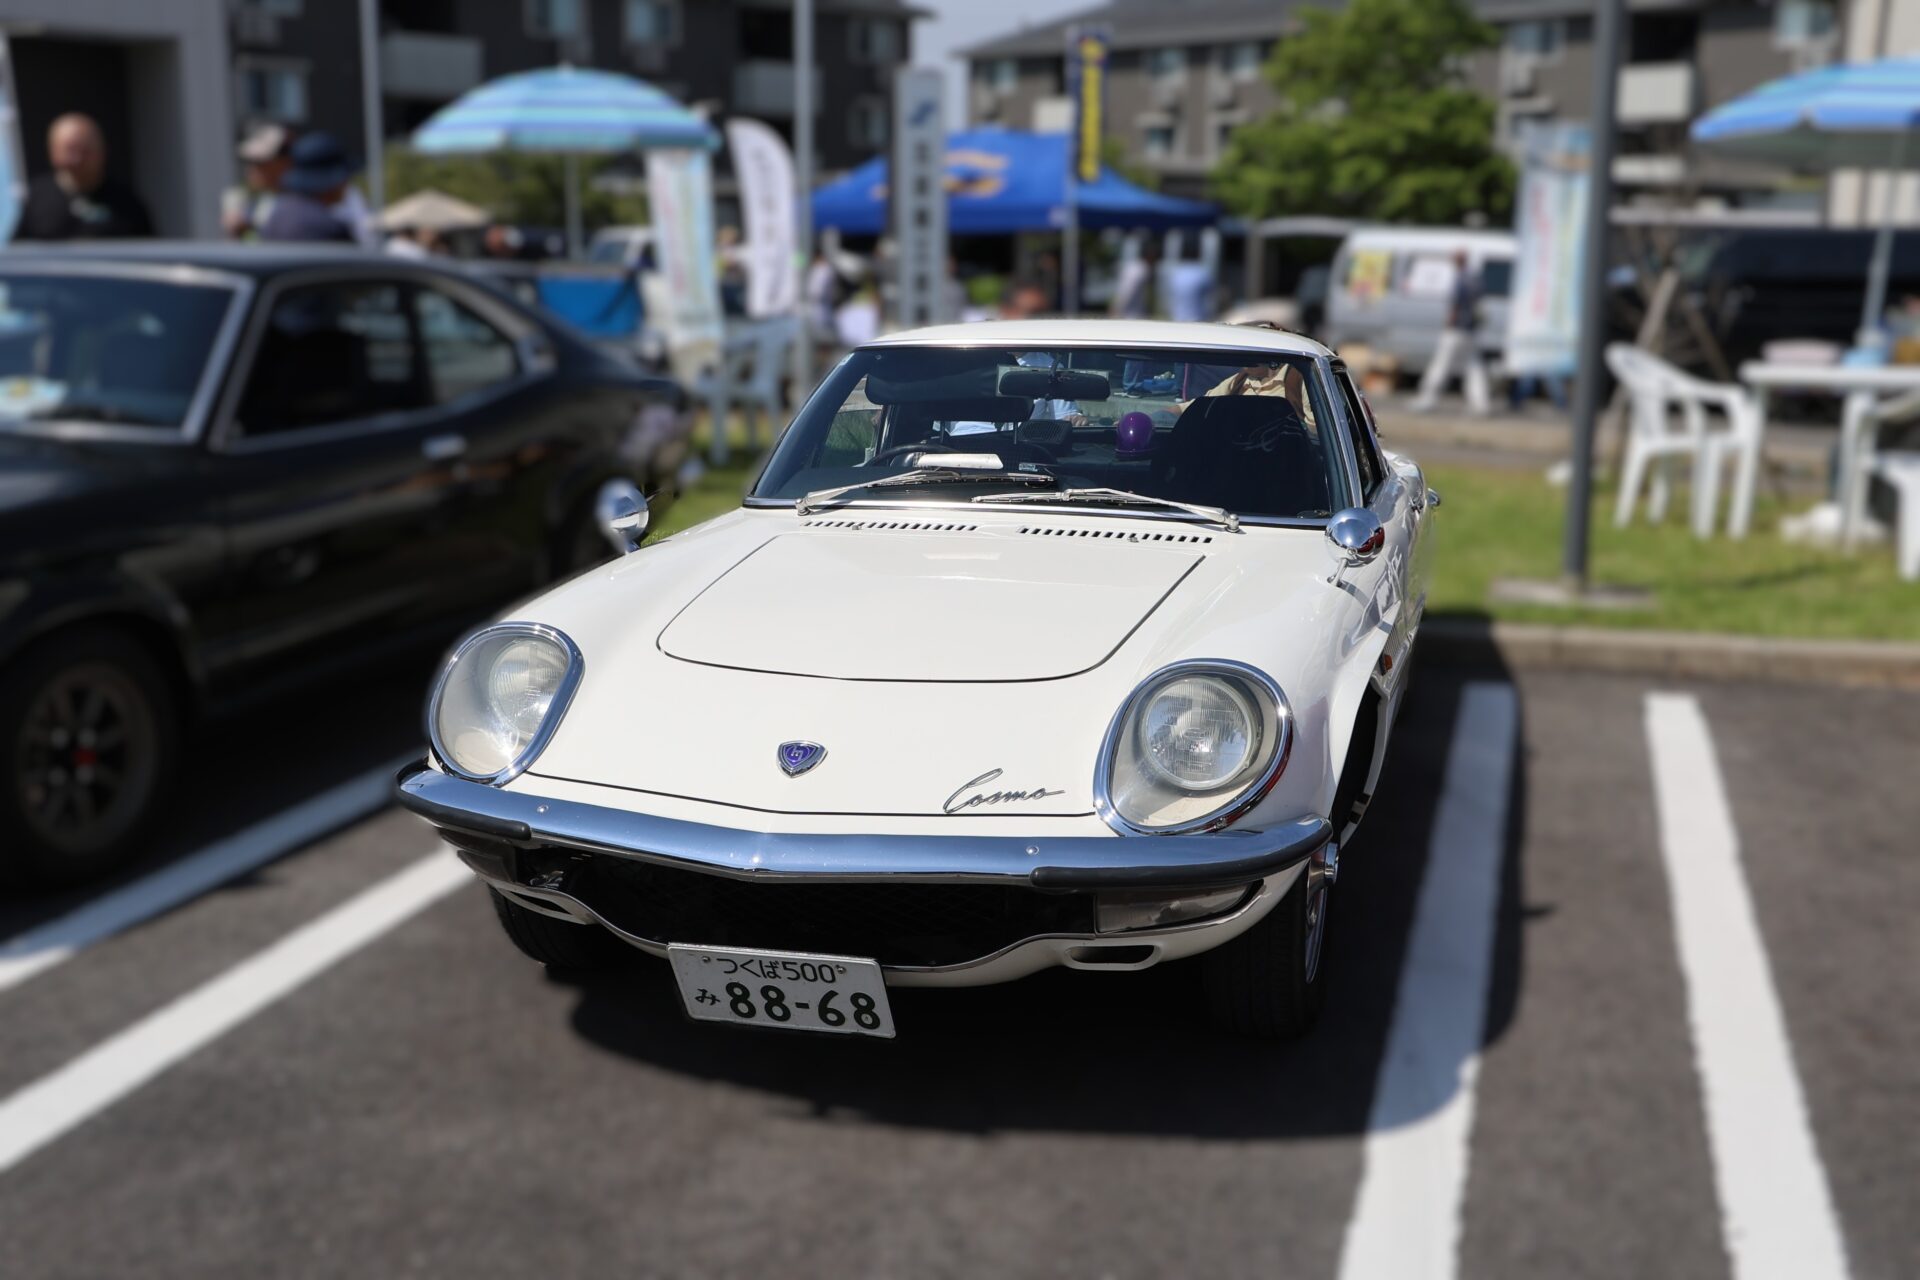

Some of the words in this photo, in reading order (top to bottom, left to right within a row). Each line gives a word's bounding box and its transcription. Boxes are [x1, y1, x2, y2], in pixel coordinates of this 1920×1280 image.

[943, 768, 1065, 814] Cosmo
[695, 988, 720, 1005] み
[726, 982, 880, 1029] 88-68
